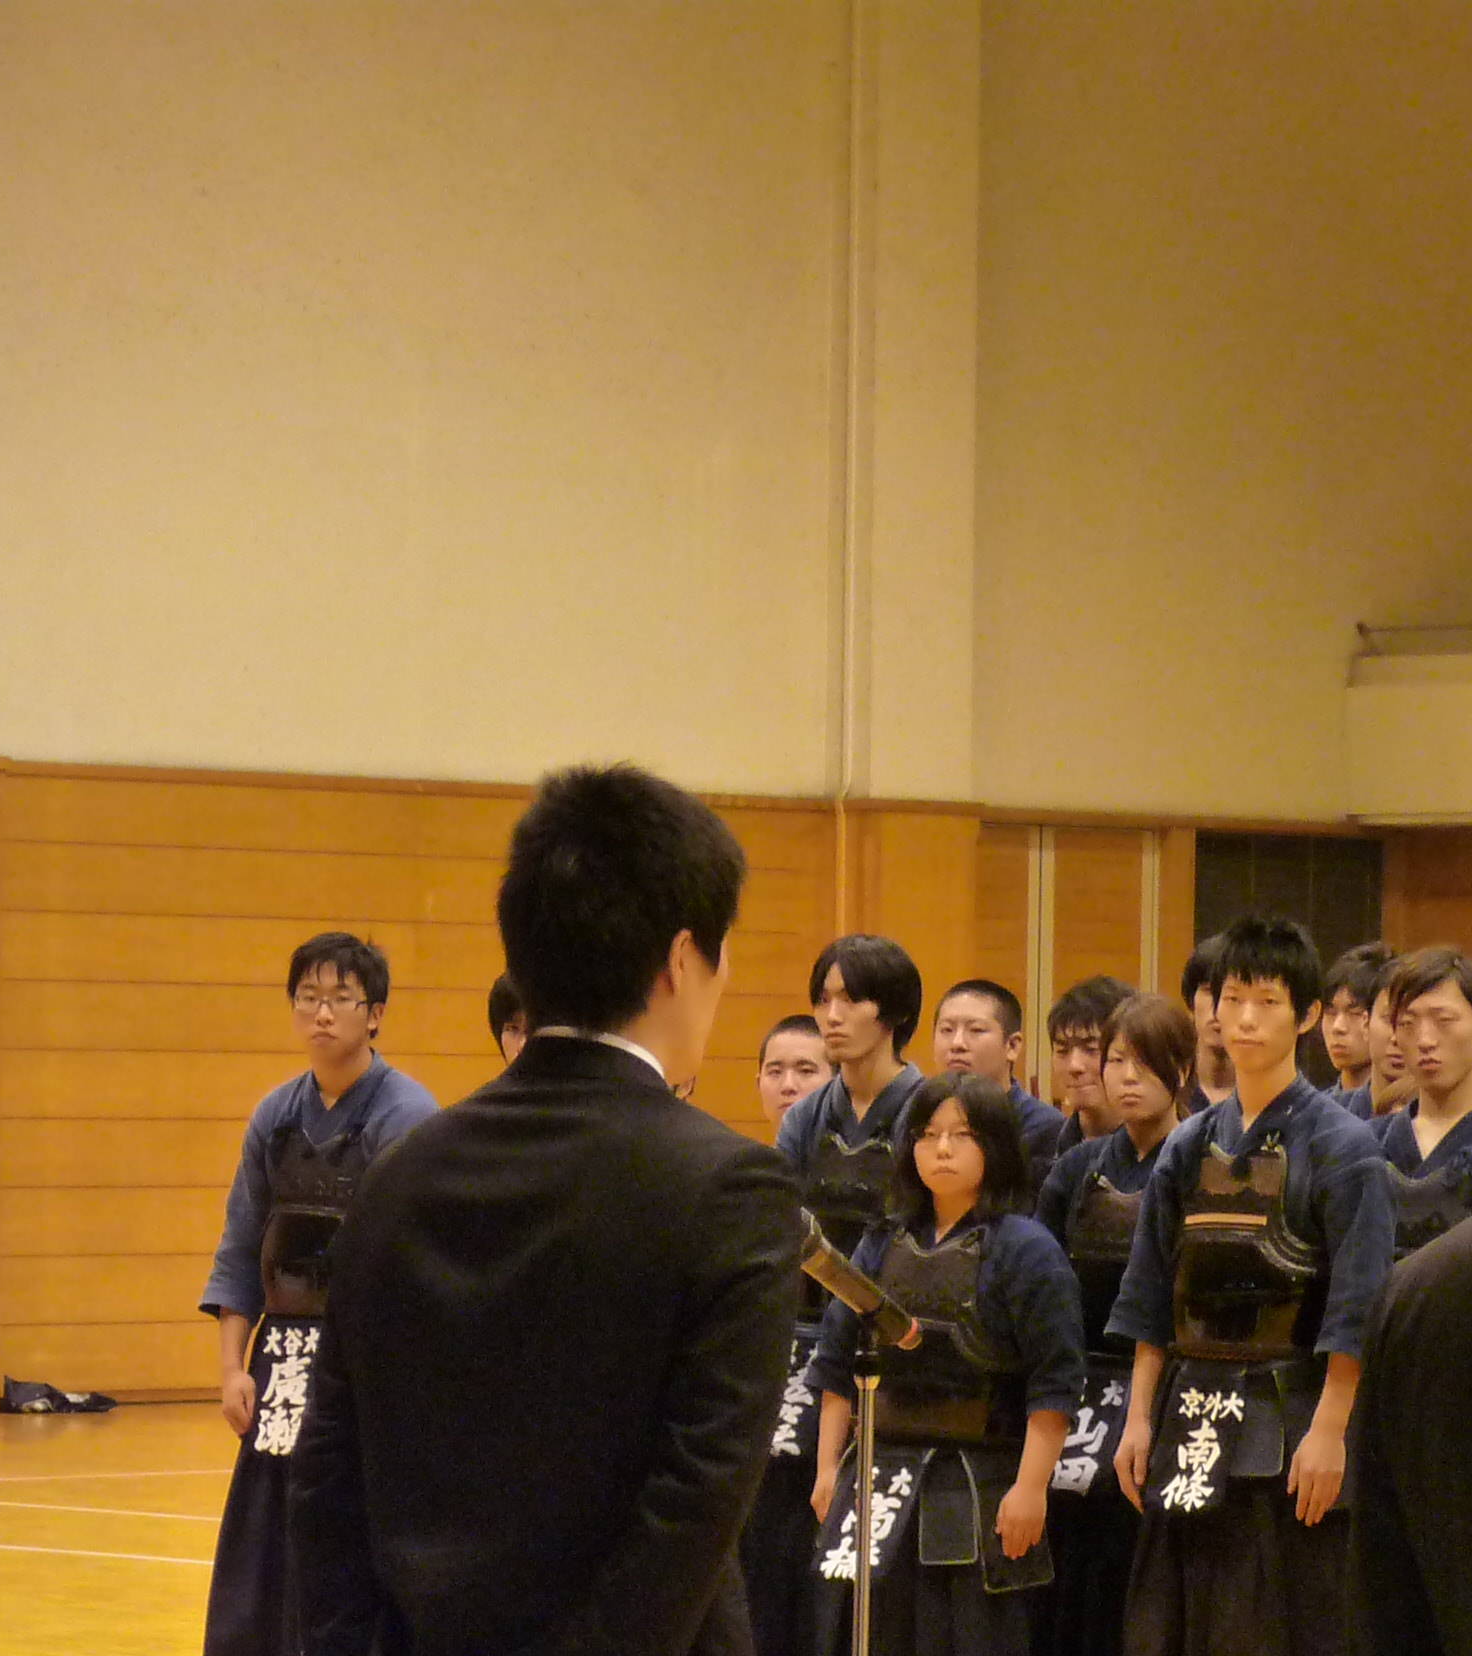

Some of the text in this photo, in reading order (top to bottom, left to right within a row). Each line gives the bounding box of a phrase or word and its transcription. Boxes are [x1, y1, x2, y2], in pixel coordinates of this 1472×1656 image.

[1178, 1386, 1245, 1422] 京外大
[1051, 1406, 1110, 1496] 山田
